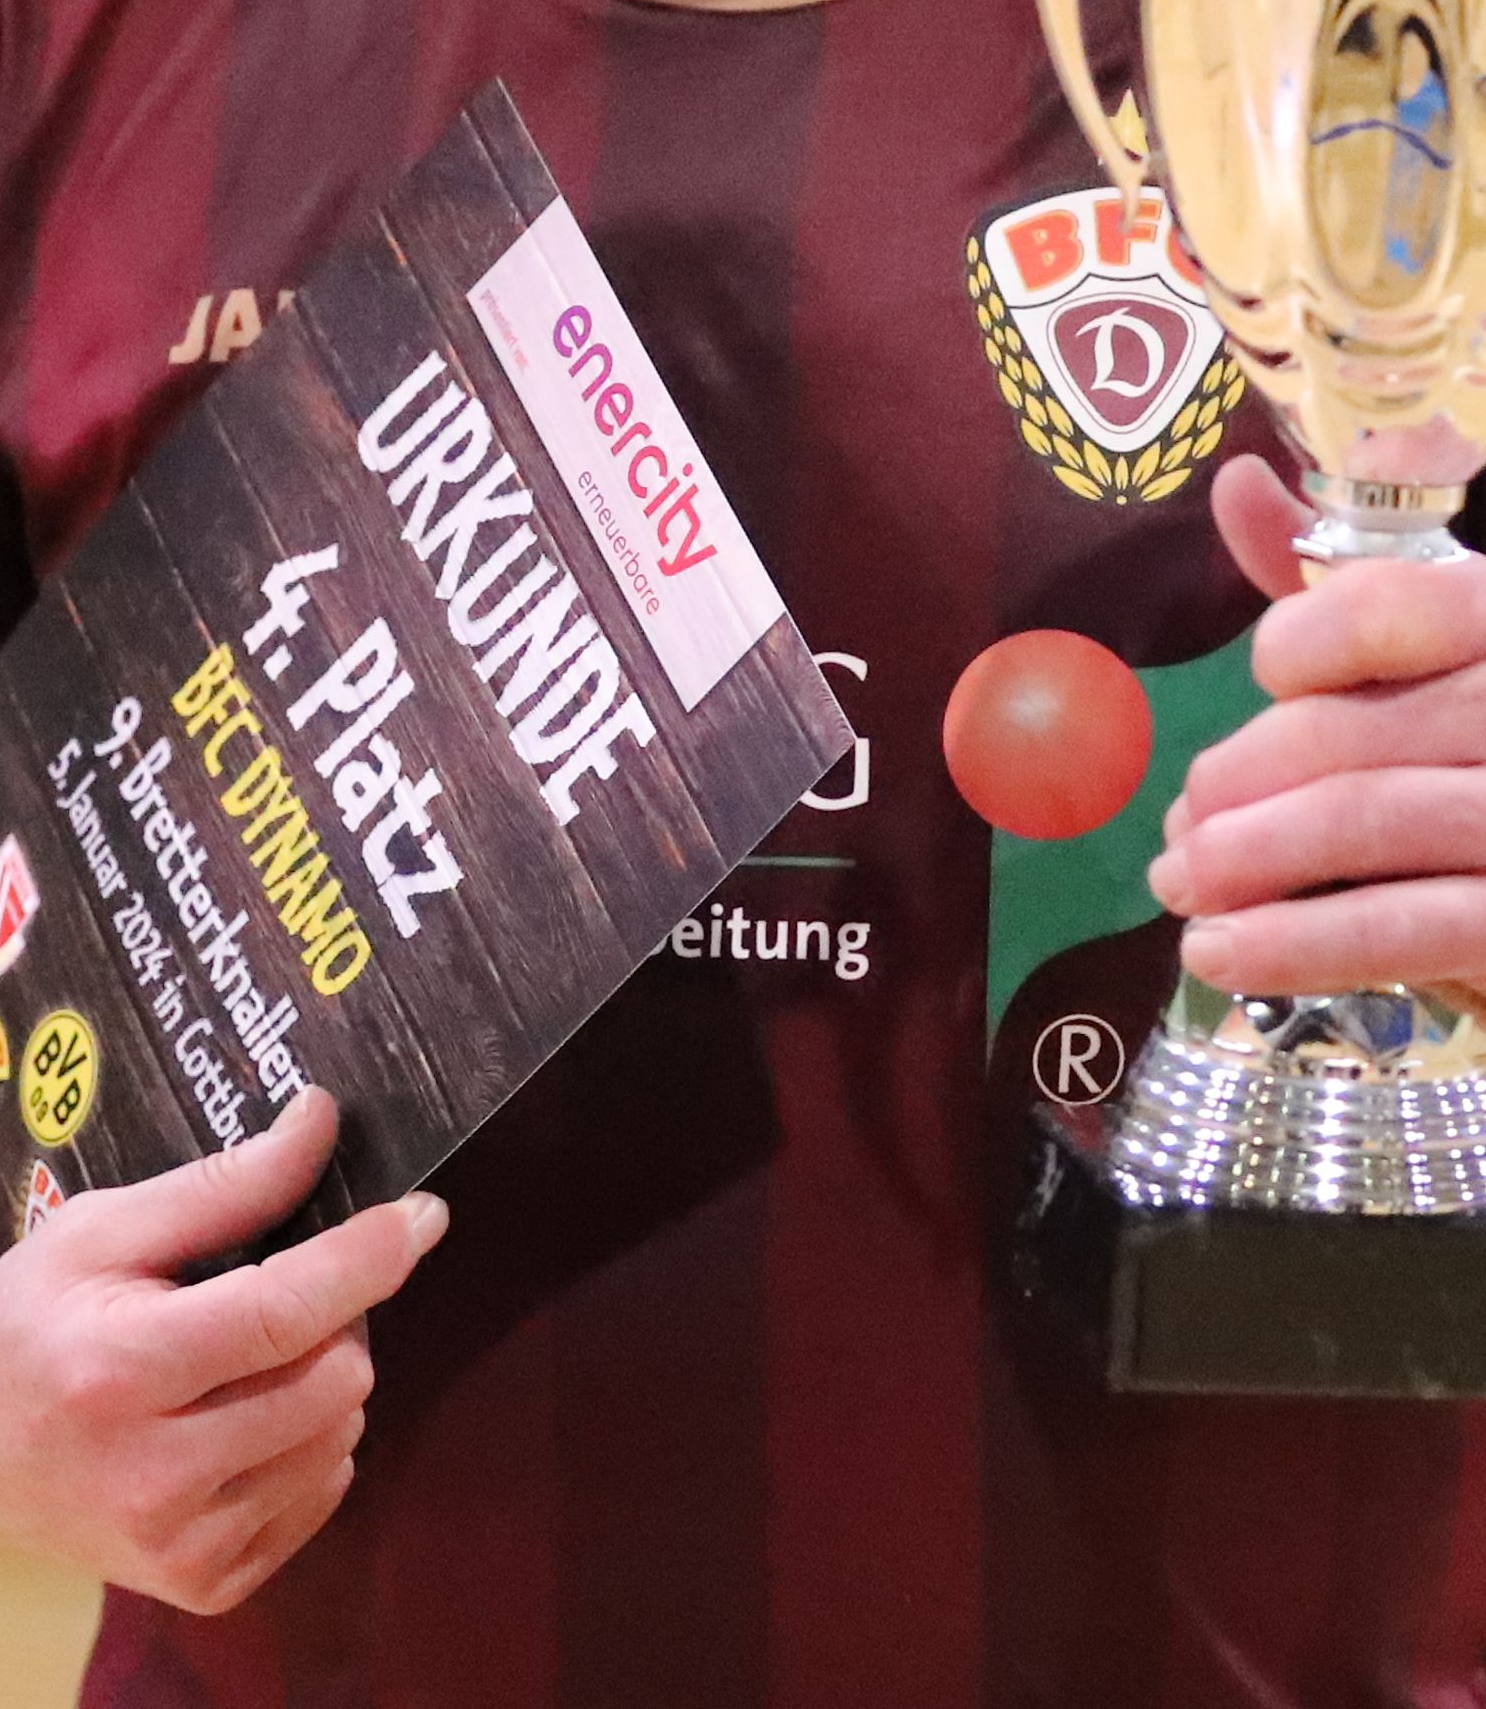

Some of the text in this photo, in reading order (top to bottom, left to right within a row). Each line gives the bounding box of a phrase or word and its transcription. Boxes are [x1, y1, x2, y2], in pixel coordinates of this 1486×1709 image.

[358, 350, 656, 825] URKUNDE
[553, 305, 717, 576] enercity
[578, 470, 660, 616] erneuerbare
[94, 696, 307, 1103] 9. Bretterknaller
[171, 642, 373, 996] BFC DYNAMO
[242, 543, 464, 938] 4. Platz
[34, 1029, 87, 1125] BVB
[47, 738, 248, 1150] 5. Januar 2024 in Cottbu
[649, 902, 870, 981] eitung
